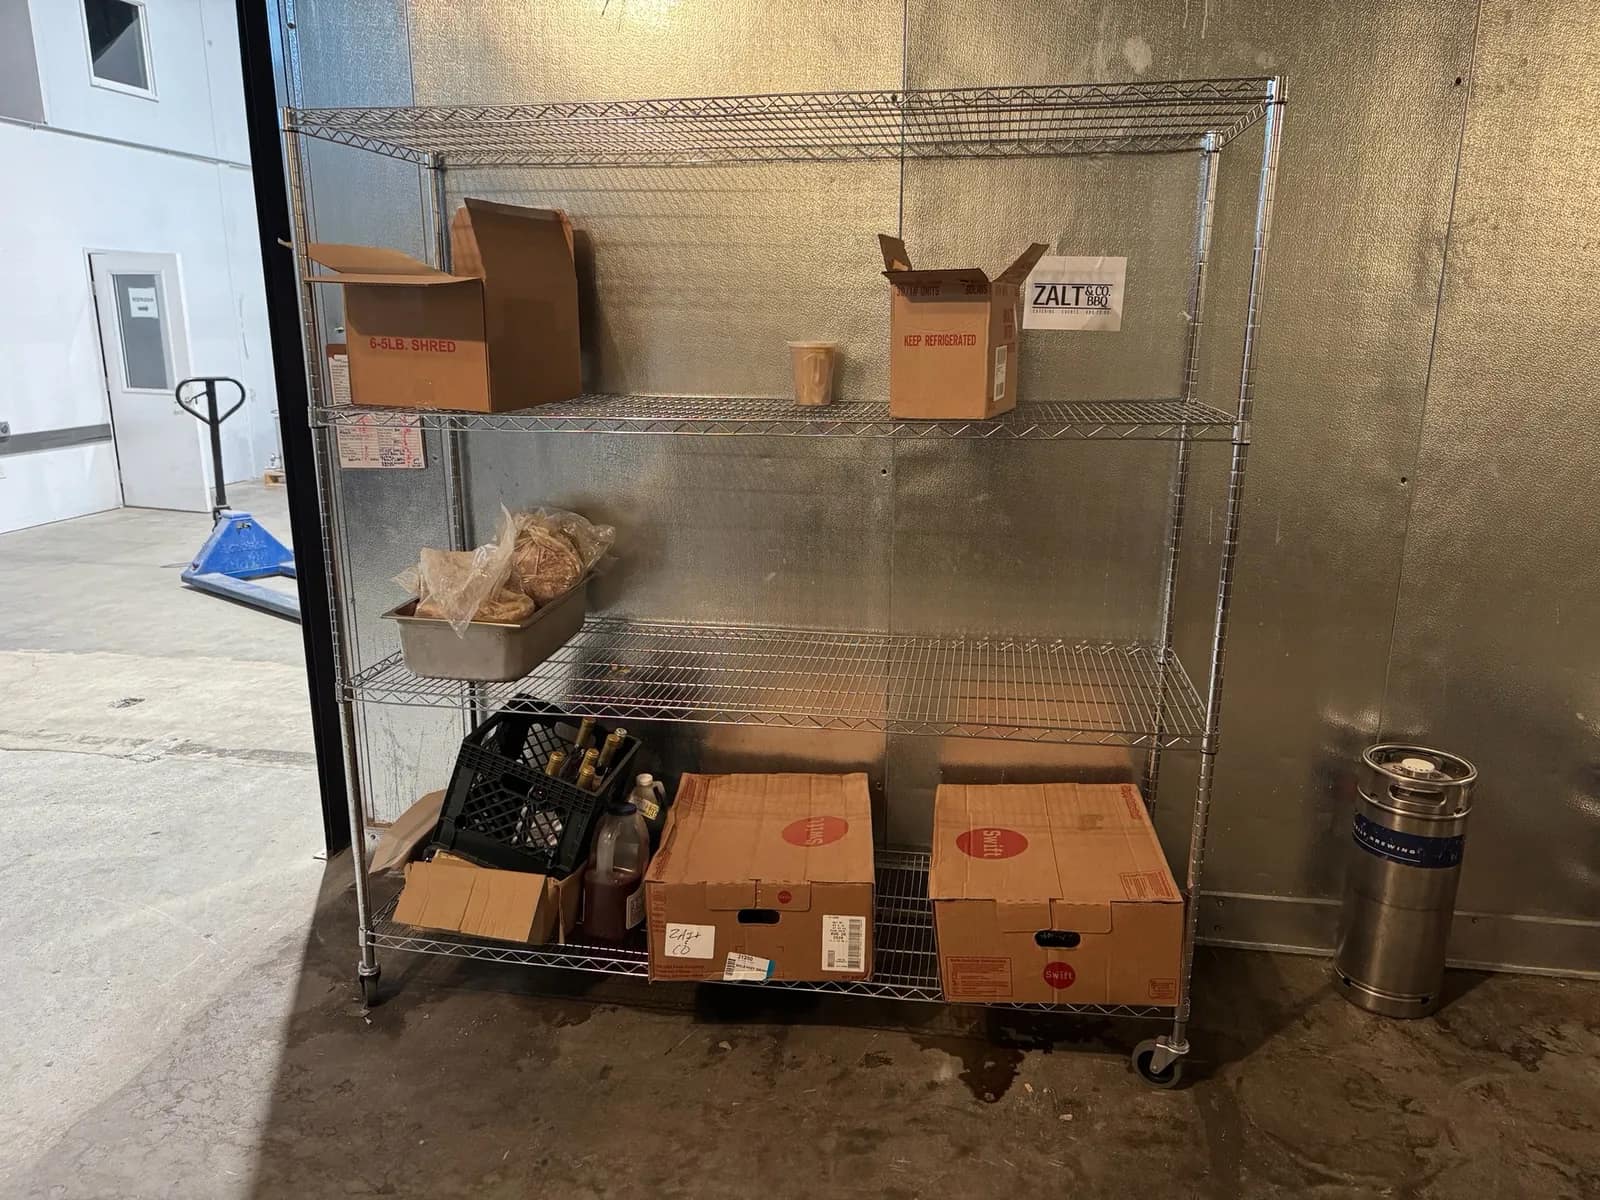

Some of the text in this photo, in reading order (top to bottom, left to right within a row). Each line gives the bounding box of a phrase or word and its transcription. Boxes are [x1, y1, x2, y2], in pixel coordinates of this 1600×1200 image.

[1032, 285, 1085, 306] ZALT
[1095, 286, 1111, 297] CO.
[1086, 296, 1108, 307] BBQ
[370, 337, 456, 353] 6-5LB. SHRED
[904, 334, 977, 347] KEEP REFRIGERATED
[805, 817, 824, 845] Swift
[983, 830, 1004, 857] Swift
[1045, 970, 1073, 980] Swift
